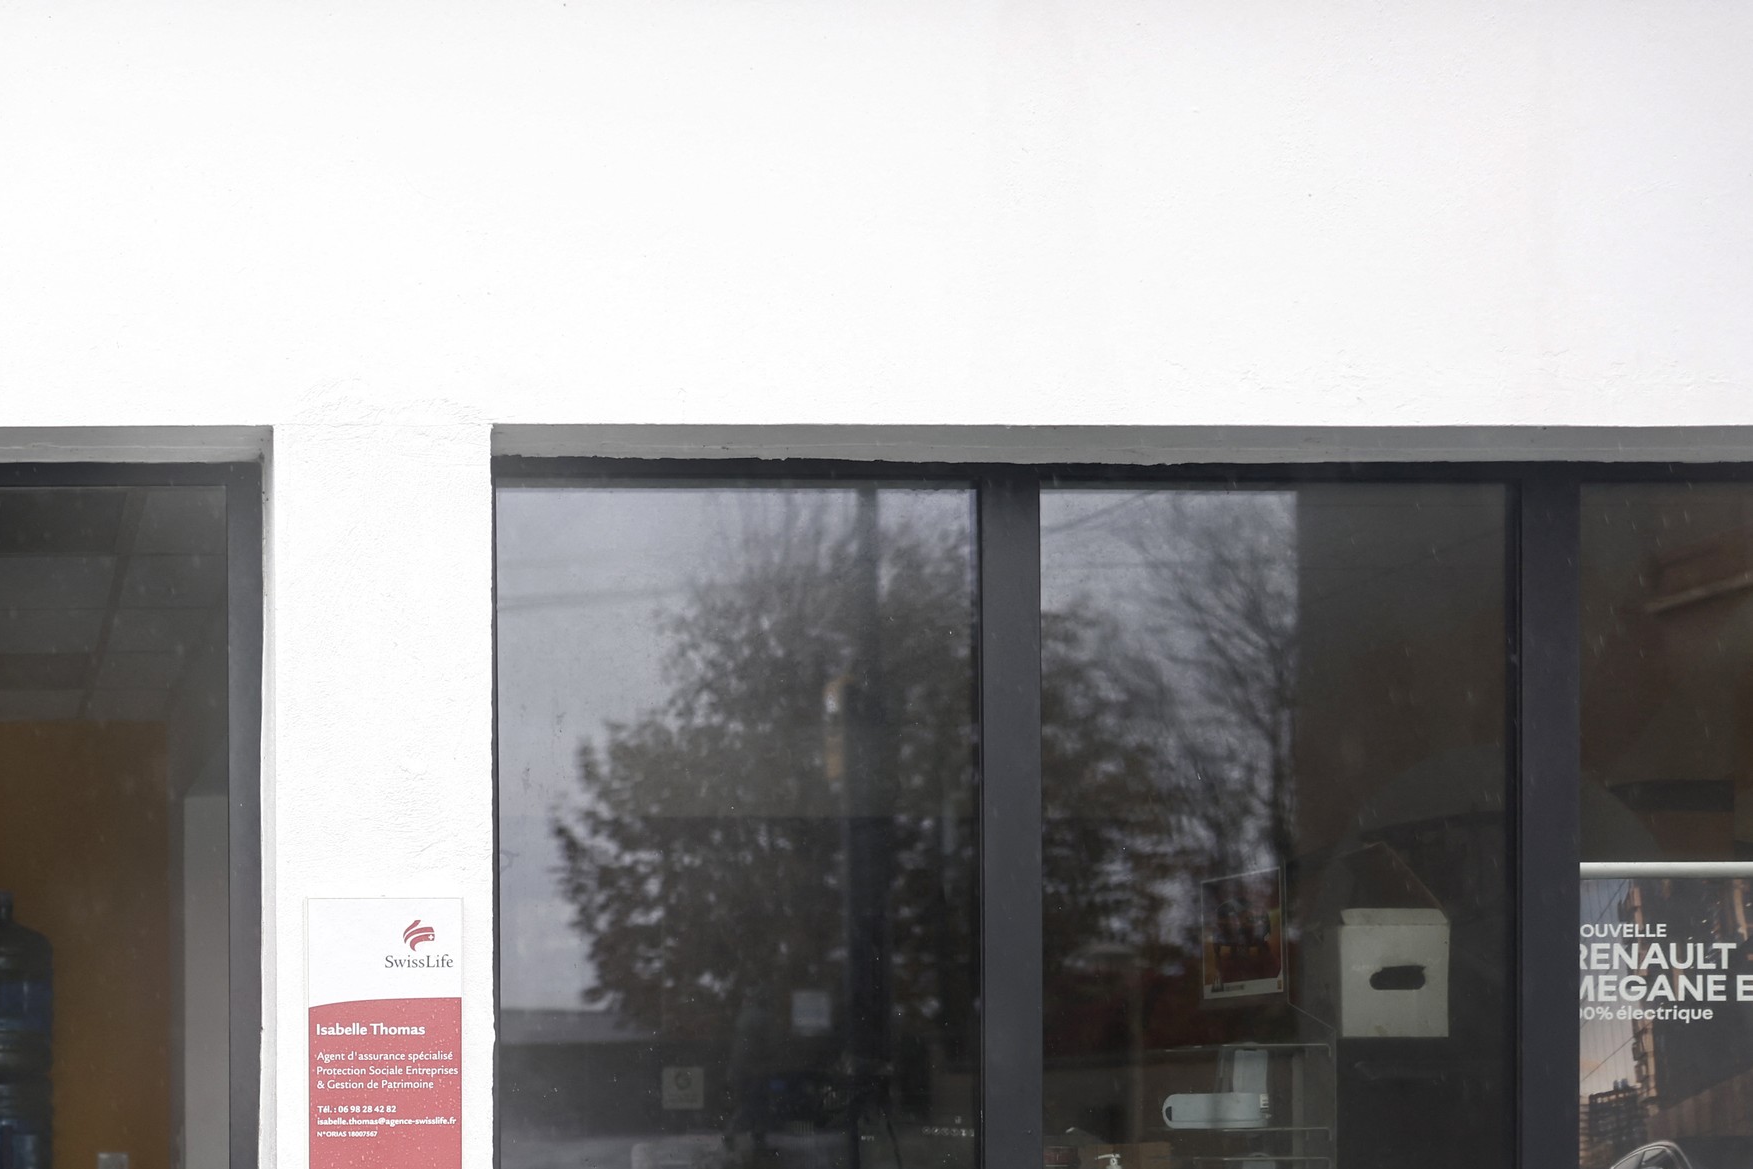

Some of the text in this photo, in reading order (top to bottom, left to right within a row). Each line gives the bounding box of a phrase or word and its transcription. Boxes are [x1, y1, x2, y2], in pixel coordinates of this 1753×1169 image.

[1580, 924, 1667, 938] OUVELLE
[385, 954, 454, 968] SwissLife
[1580, 1005, 1714, 1024] 0% électrique
[316, 1023, 426, 1036] Isabelle Thomas
[316, 1050, 453, 1063] Agent d'assurance spécialisé
[316, 1066, 458, 1078] Protection Sociale Entreprises
[316, 1080, 434, 1090] & Gestion de Patrimoine
[338, 1105, 348, 1113] 06
[350, 1105, 361, 1113] 98
[362, 1105, 373, 1113] 28
[374, 1105, 385, 1113] 42
[386, 1105, 397, 1113] 82
[317, 1117, 457, 1127] isabelle.thomas@agence-swisslife.fr
